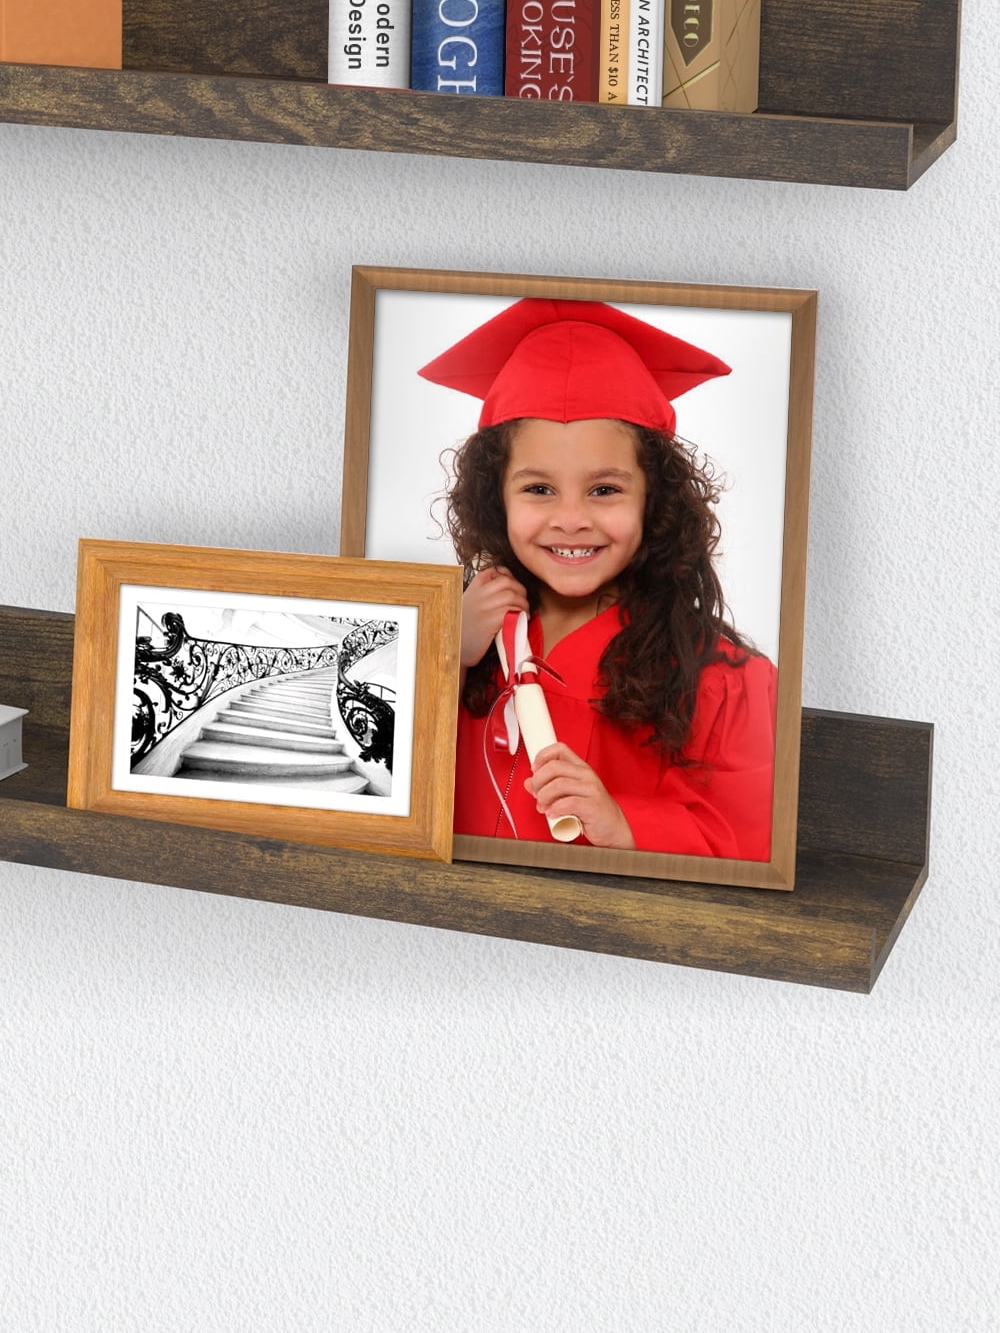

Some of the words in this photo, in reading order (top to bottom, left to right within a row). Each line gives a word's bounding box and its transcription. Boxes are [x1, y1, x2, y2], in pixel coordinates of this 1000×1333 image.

[608, 24, 620, 63] THAN
[636, 15, 650, 105] ARCHITECT
[608, 66, 618, 86] $10
